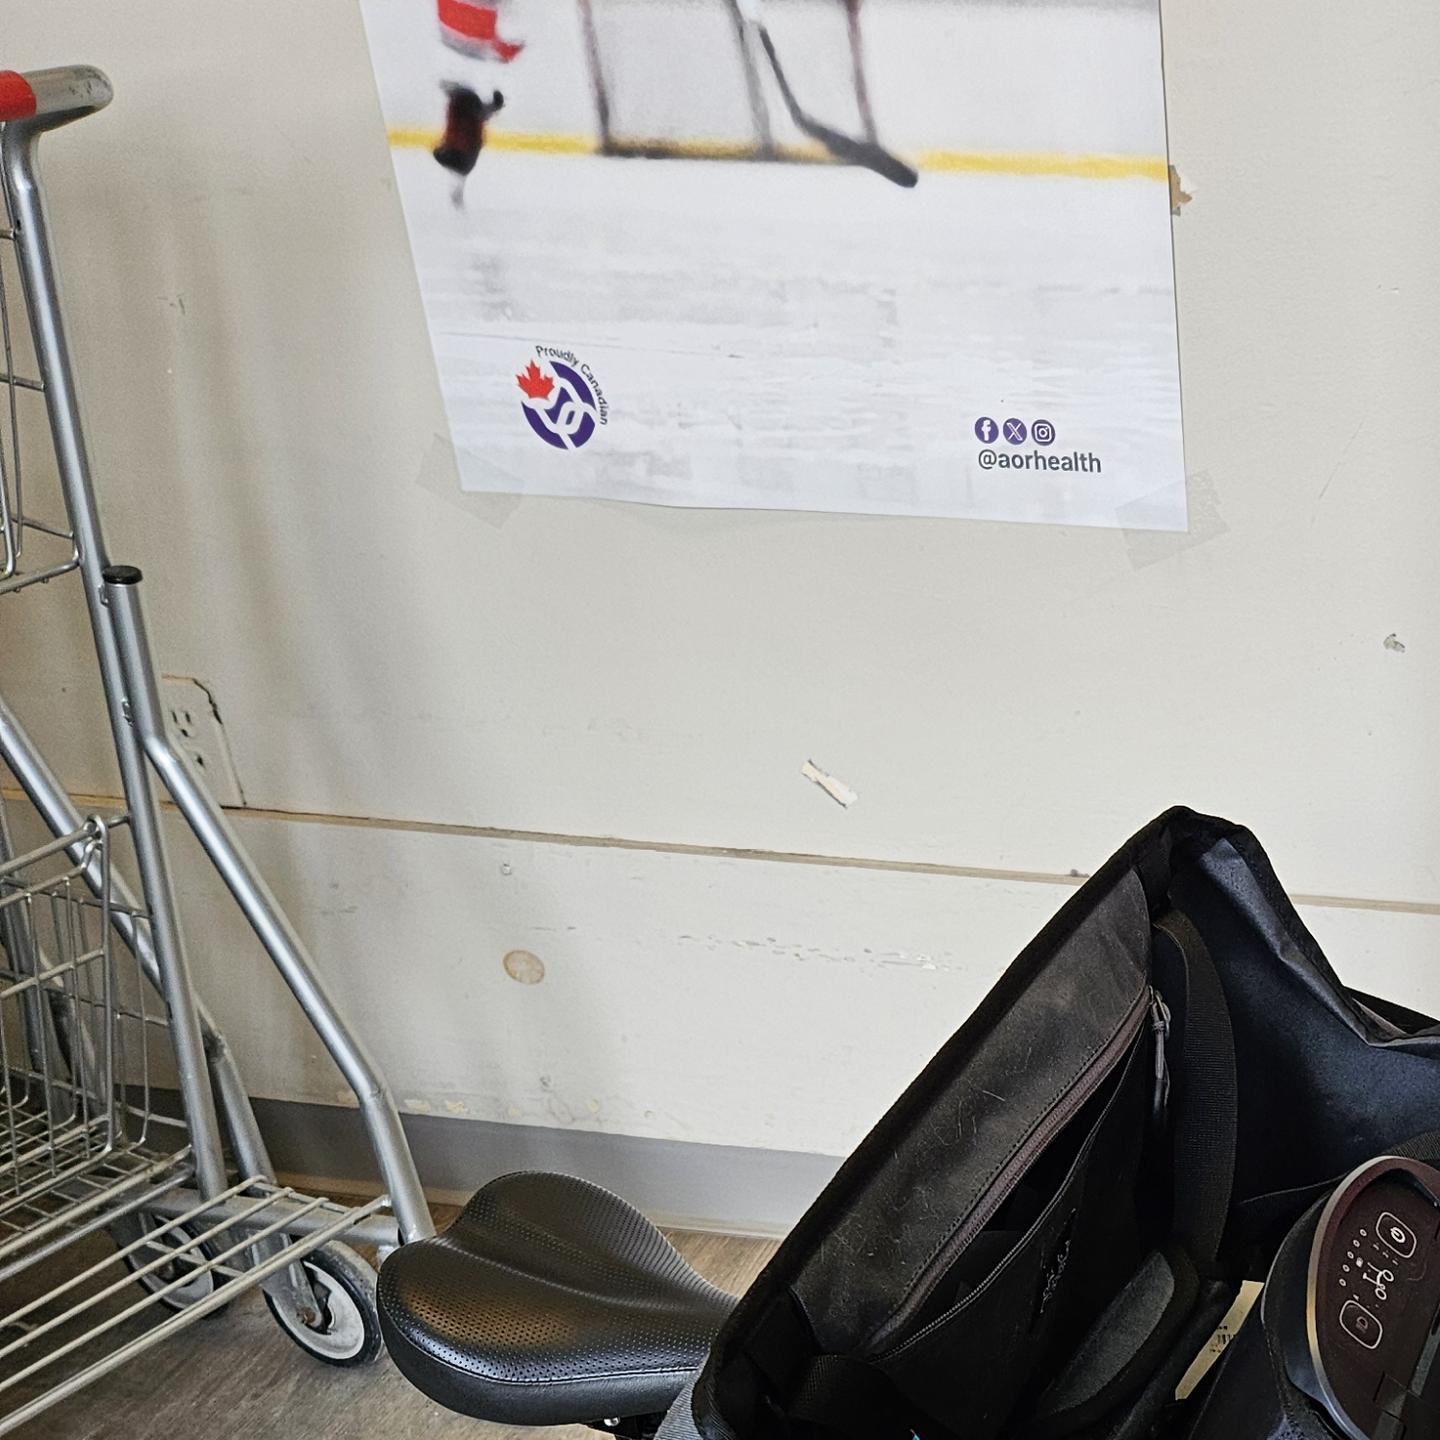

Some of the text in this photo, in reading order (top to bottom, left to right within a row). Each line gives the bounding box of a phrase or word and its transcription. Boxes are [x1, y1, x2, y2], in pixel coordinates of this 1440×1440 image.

[535, 345, 608, 426] Proudly Canadian
[978, 449, 1101, 473] @aorhealth
